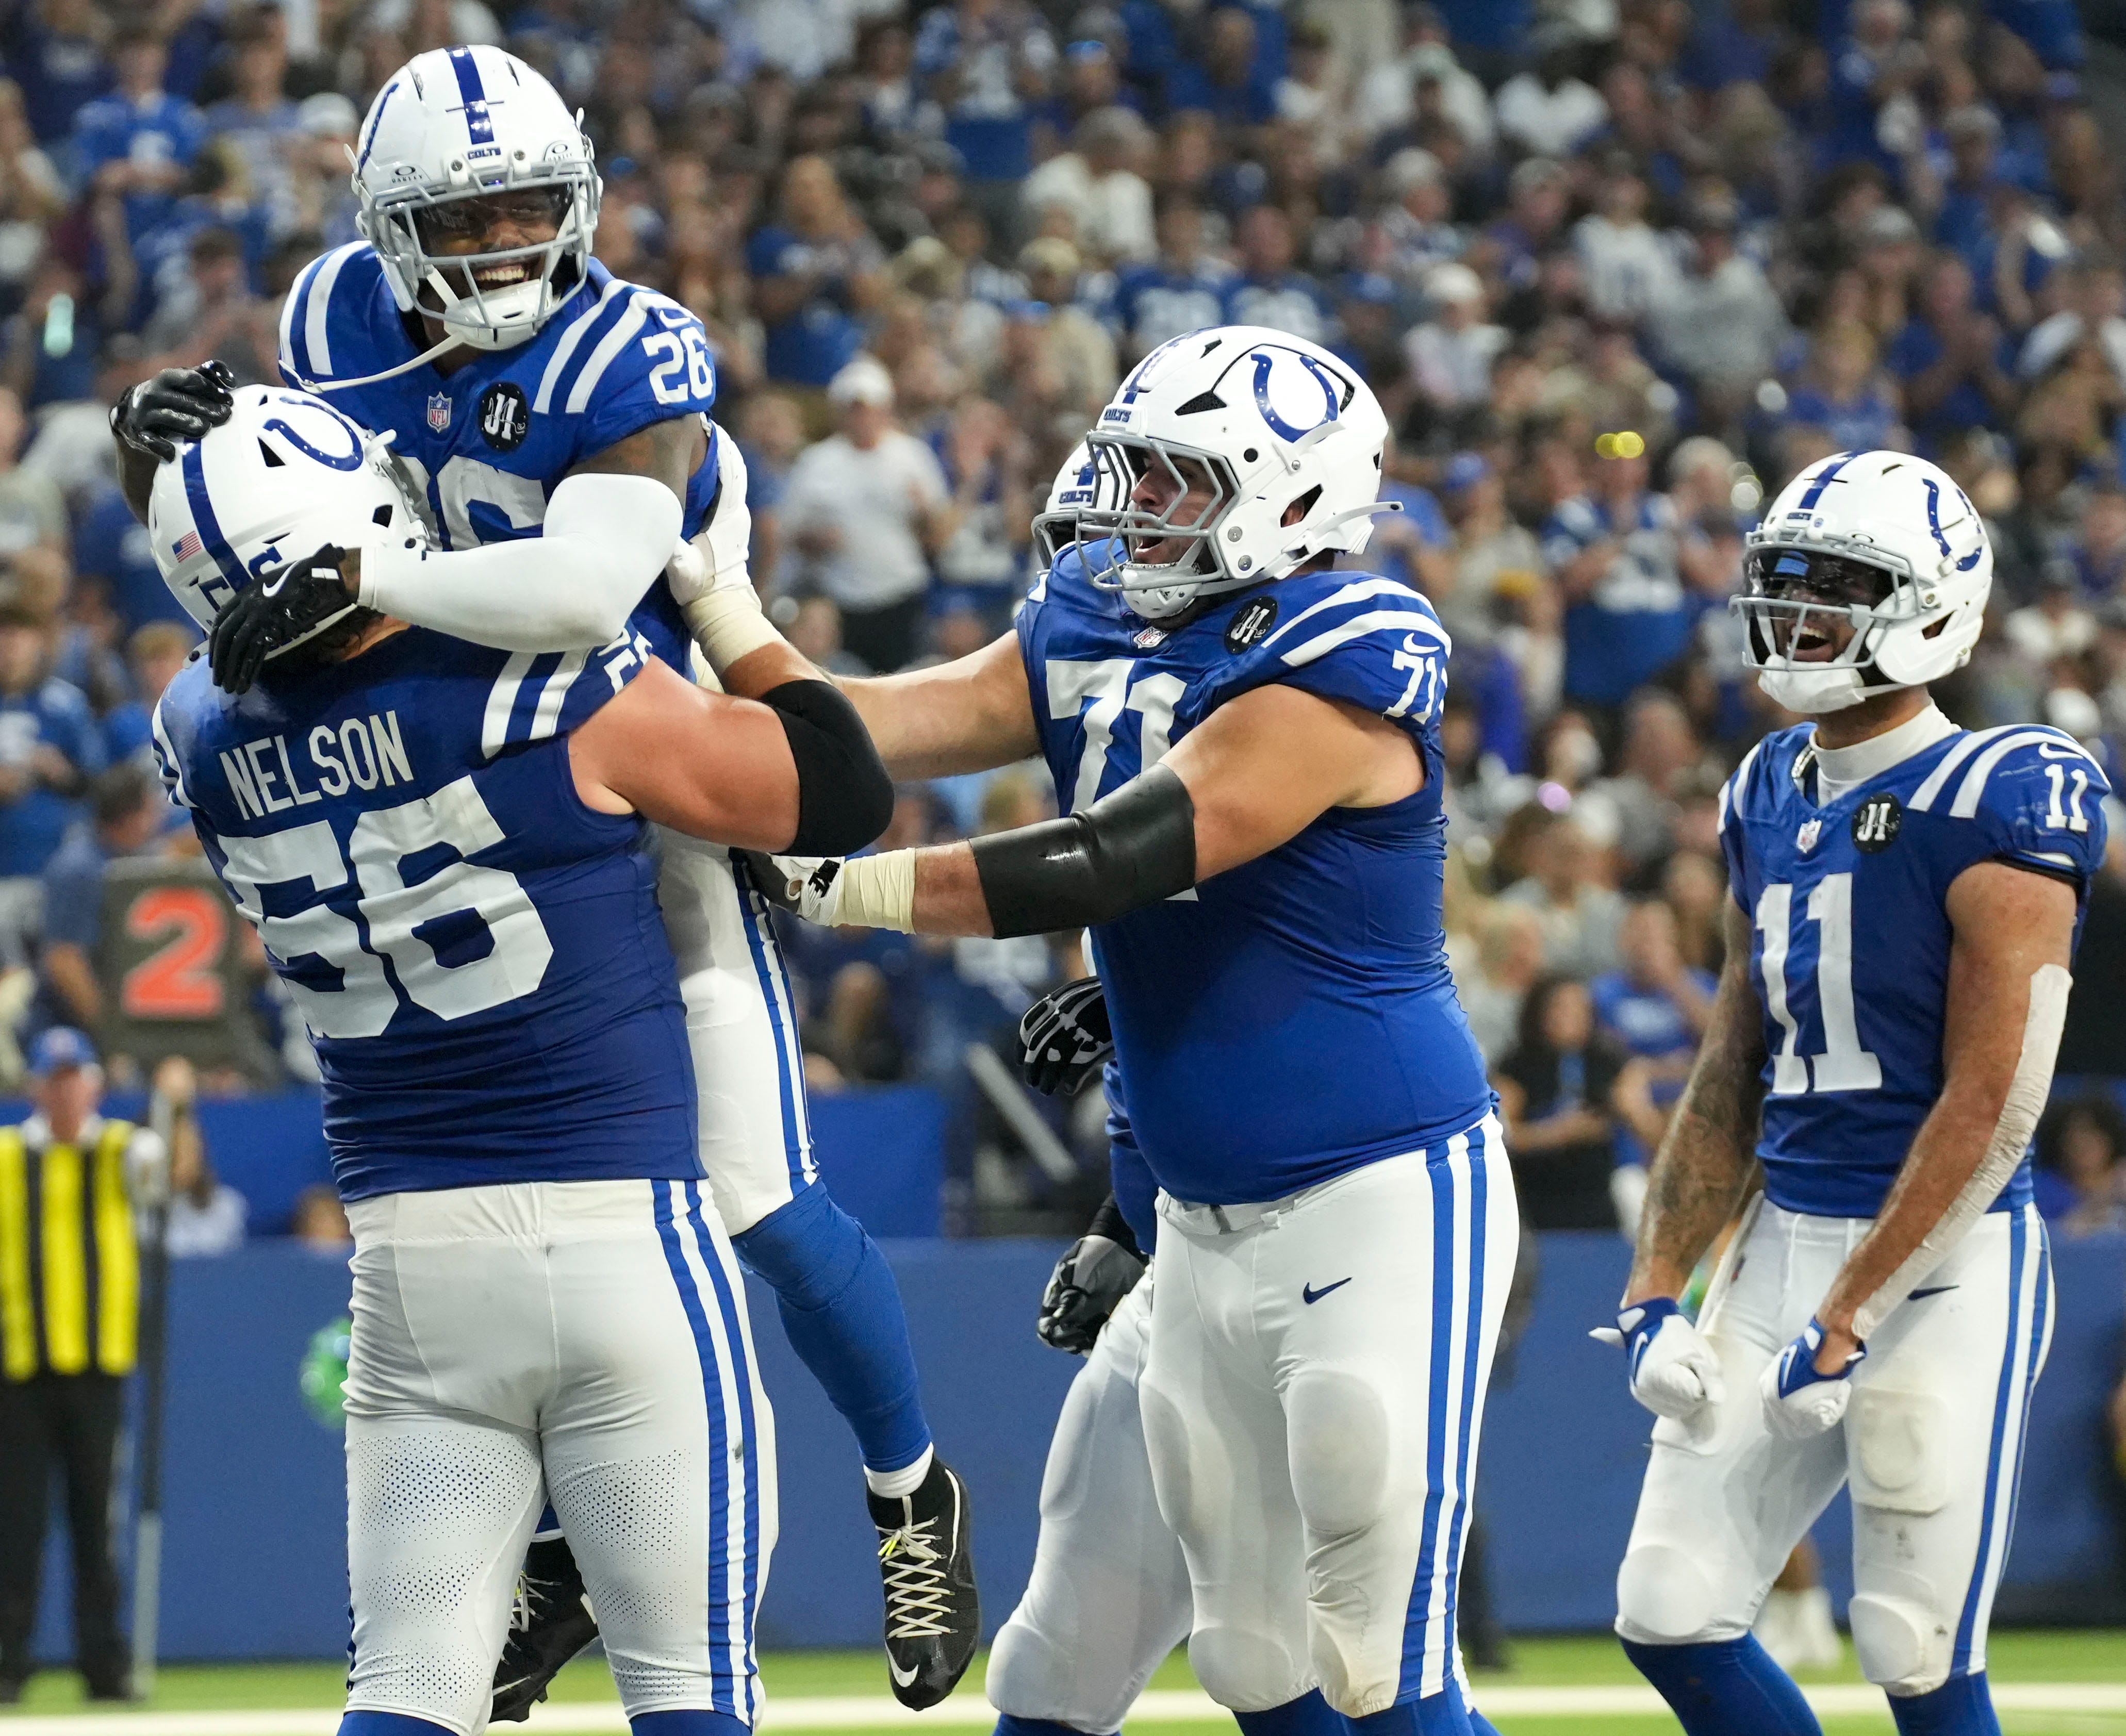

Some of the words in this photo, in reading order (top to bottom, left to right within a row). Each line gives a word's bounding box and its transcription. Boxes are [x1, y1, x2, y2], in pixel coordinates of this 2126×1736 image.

[641, 326, 713, 405] 26
[431, 409, 446, 427] NFL
[1139, 632, 1159, 643] NFL
[1382, 649, 1438, 725] 71
[219, 709, 414, 821] NELSON
[2044, 764, 2088, 832] 11
[217, 774, 554, 1038] 56
[124, 887, 226, 1018] 2
[1755, 871, 1883, 1095] 11
